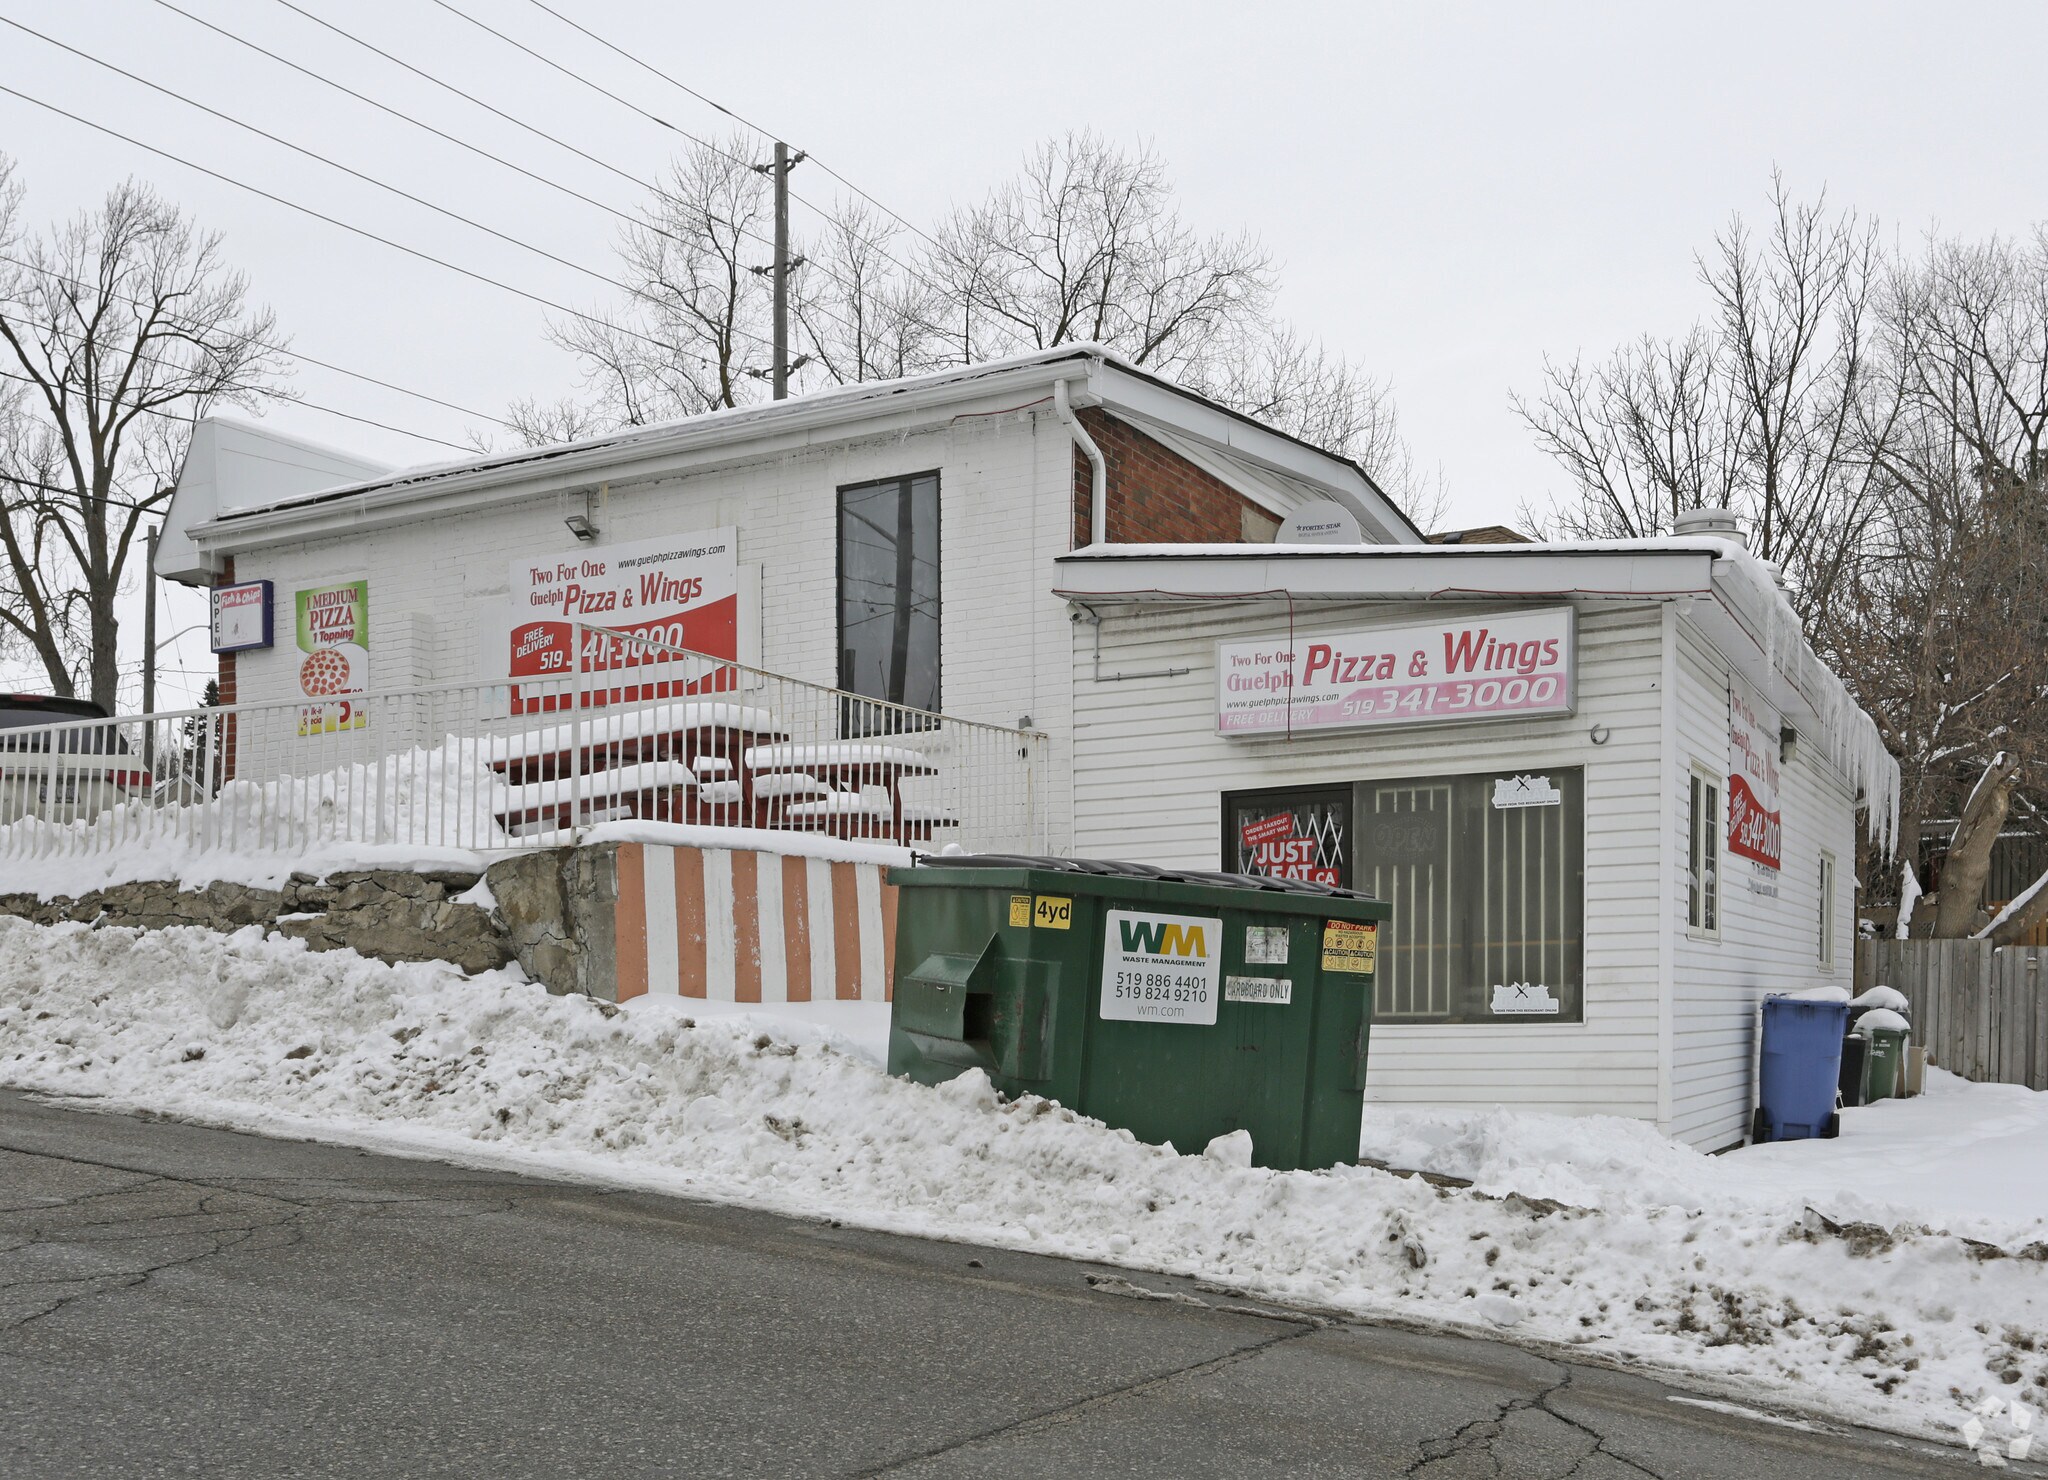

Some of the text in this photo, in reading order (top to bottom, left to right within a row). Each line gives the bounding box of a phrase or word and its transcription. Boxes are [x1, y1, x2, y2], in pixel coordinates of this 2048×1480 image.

[618, 545, 726, 569] www.guelphpizzawings.com
[530, 560, 606, 585] Two For One
[236, 593, 241, 604] &
[313, 588, 358, 609] MEDIUM
[530, 571, 702, 616] Guelph Pizza & Wings
[309, 605, 355, 631] PIZZA
[313, 628, 354, 643] 1 Topping
[524, 626, 544, 644] FREE
[517, 633, 555, 659] DELIVERY
[540, 650, 563, 670] 519
[1231, 651, 1296, 667] Two For One
[1303, 629, 1559, 687] Pizza & Wings
[1227, 669, 1294, 693] Guelph
[1226, 693, 1339, 709] www.guelphpizzawings.com
[1376, 677, 1558, 714] 341-3000
[1227, 709, 1314, 726] FREE DELIVERY
[1246, 817, 1288, 835] ORDER TAKEOUT
[1258, 829, 1276, 839] SMART
[1277, 824, 1290, 833] WAY
[1257, 840, 1313, 864] JUST
[1037, 901, 1070, 923] 4yd
[1119, 919, 1207, 958] WM
[1122, 956, 1207, 967] WASTE MANAGEMENT
[1117, 972, 1207, 990] 519 886 4401
[1116, 986, 1207, 1002] 519 824 9210
[1270, 984, 1289, 999] ONLY
[1137, 1005, 1185, 1017] wm.com
